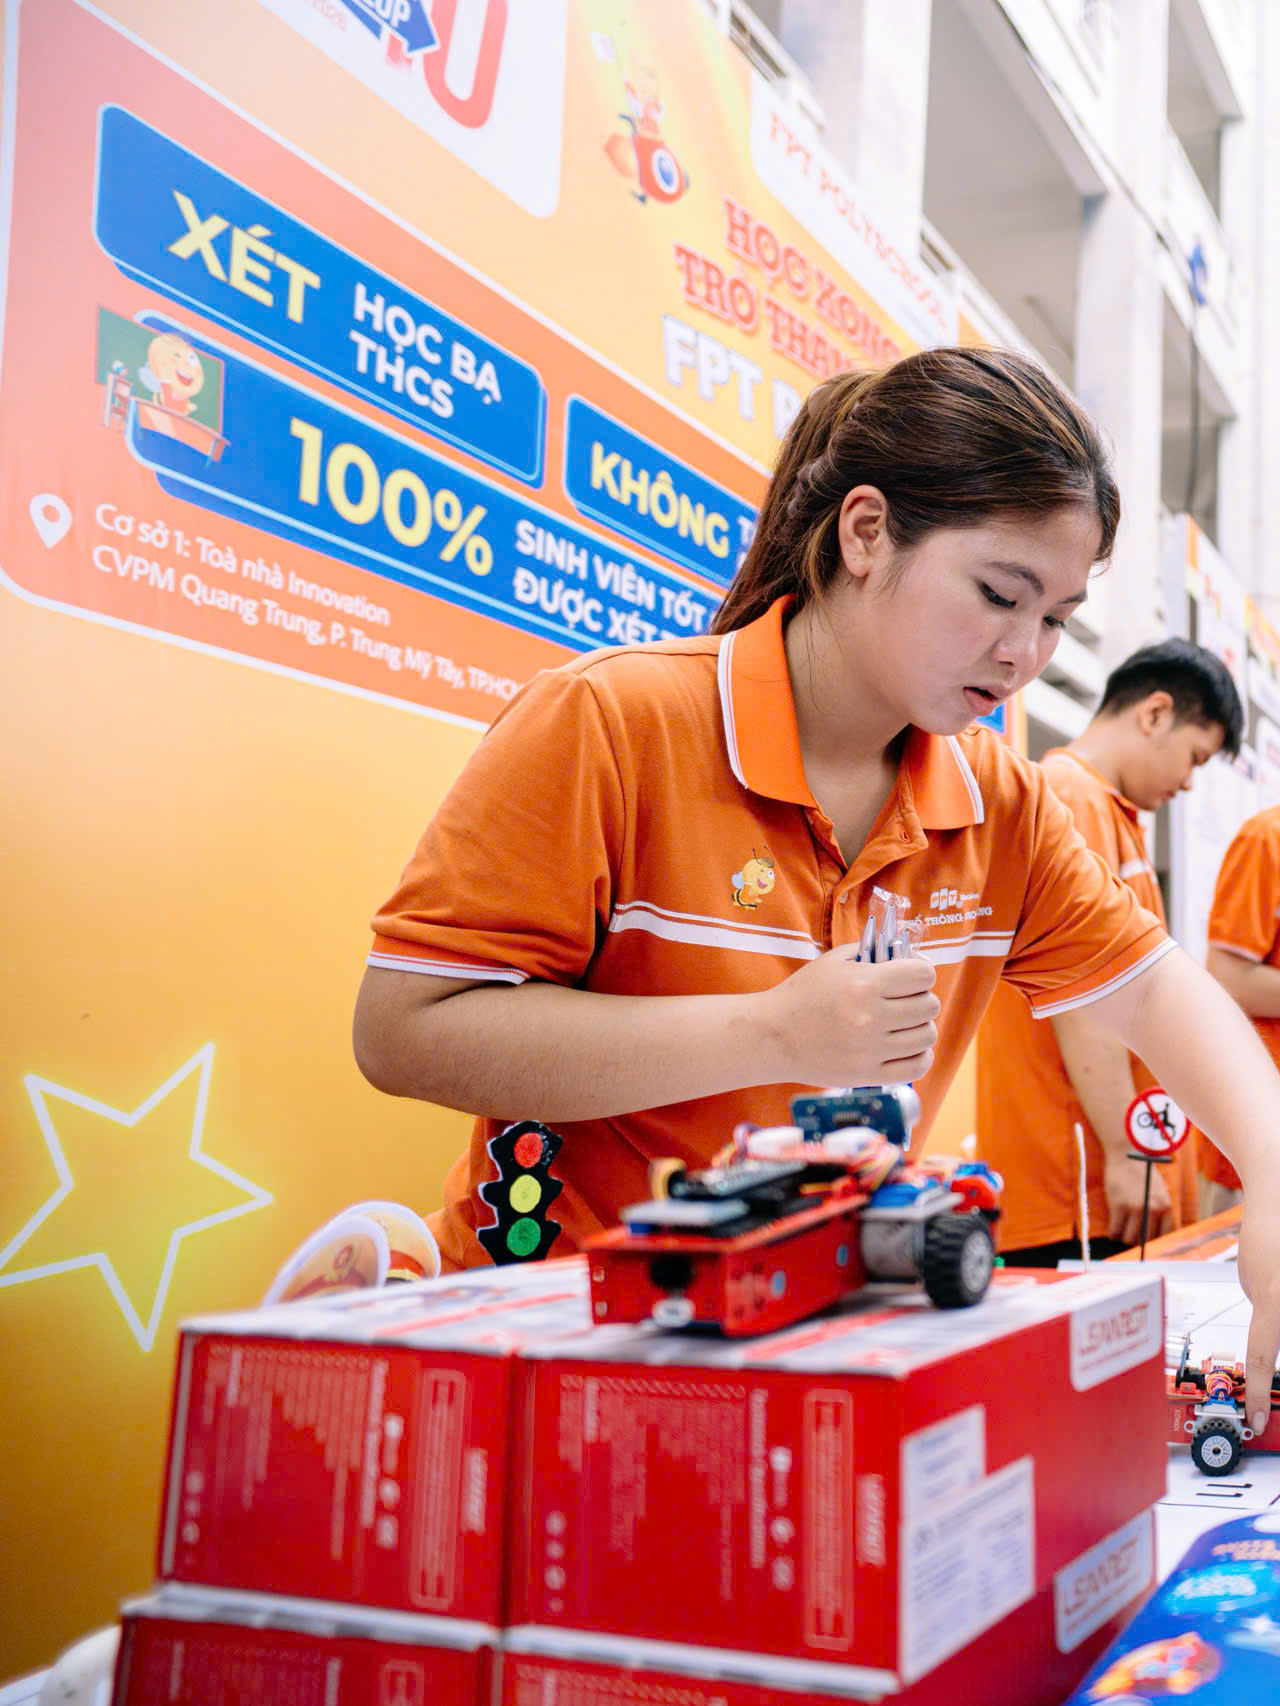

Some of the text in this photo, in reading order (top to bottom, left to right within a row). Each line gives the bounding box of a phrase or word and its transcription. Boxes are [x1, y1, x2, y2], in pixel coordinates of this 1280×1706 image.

[167, 188, 321, 324] XÉT
[349, 330, 455, 419] THCS
[353, 282, 502, 405] HỌC BẠ
[662, 312, 763, 422] FPT
[290, 417, 494, 577] 100%
[590, 440, 729, 559] KHÔNG
[92, 544, 176, 593] CVPM
[179, 572, 259, 626] Quang
[261, 597, 327, 647] Trung,
[330, 621, 347, 648] P.
[350, 626, 402, 672] Trung
[403, 646, 432, 680] Mỹ
[95, 502, 135, 537] Cơ
[136, 519, 171, 550] sở
[173, 529, 192, 558] 1:
[241, 556, 285, 590] nhà
[287, 569, 391, 628] Innovation
[512, 566, 658, 645] ĐƯỢC XÉT
[514, 518, 708, 633] SINH VIÊN TỐT
[925, 912, 964, 925] THÔNG
[929, 888, 957, 910] FPT
